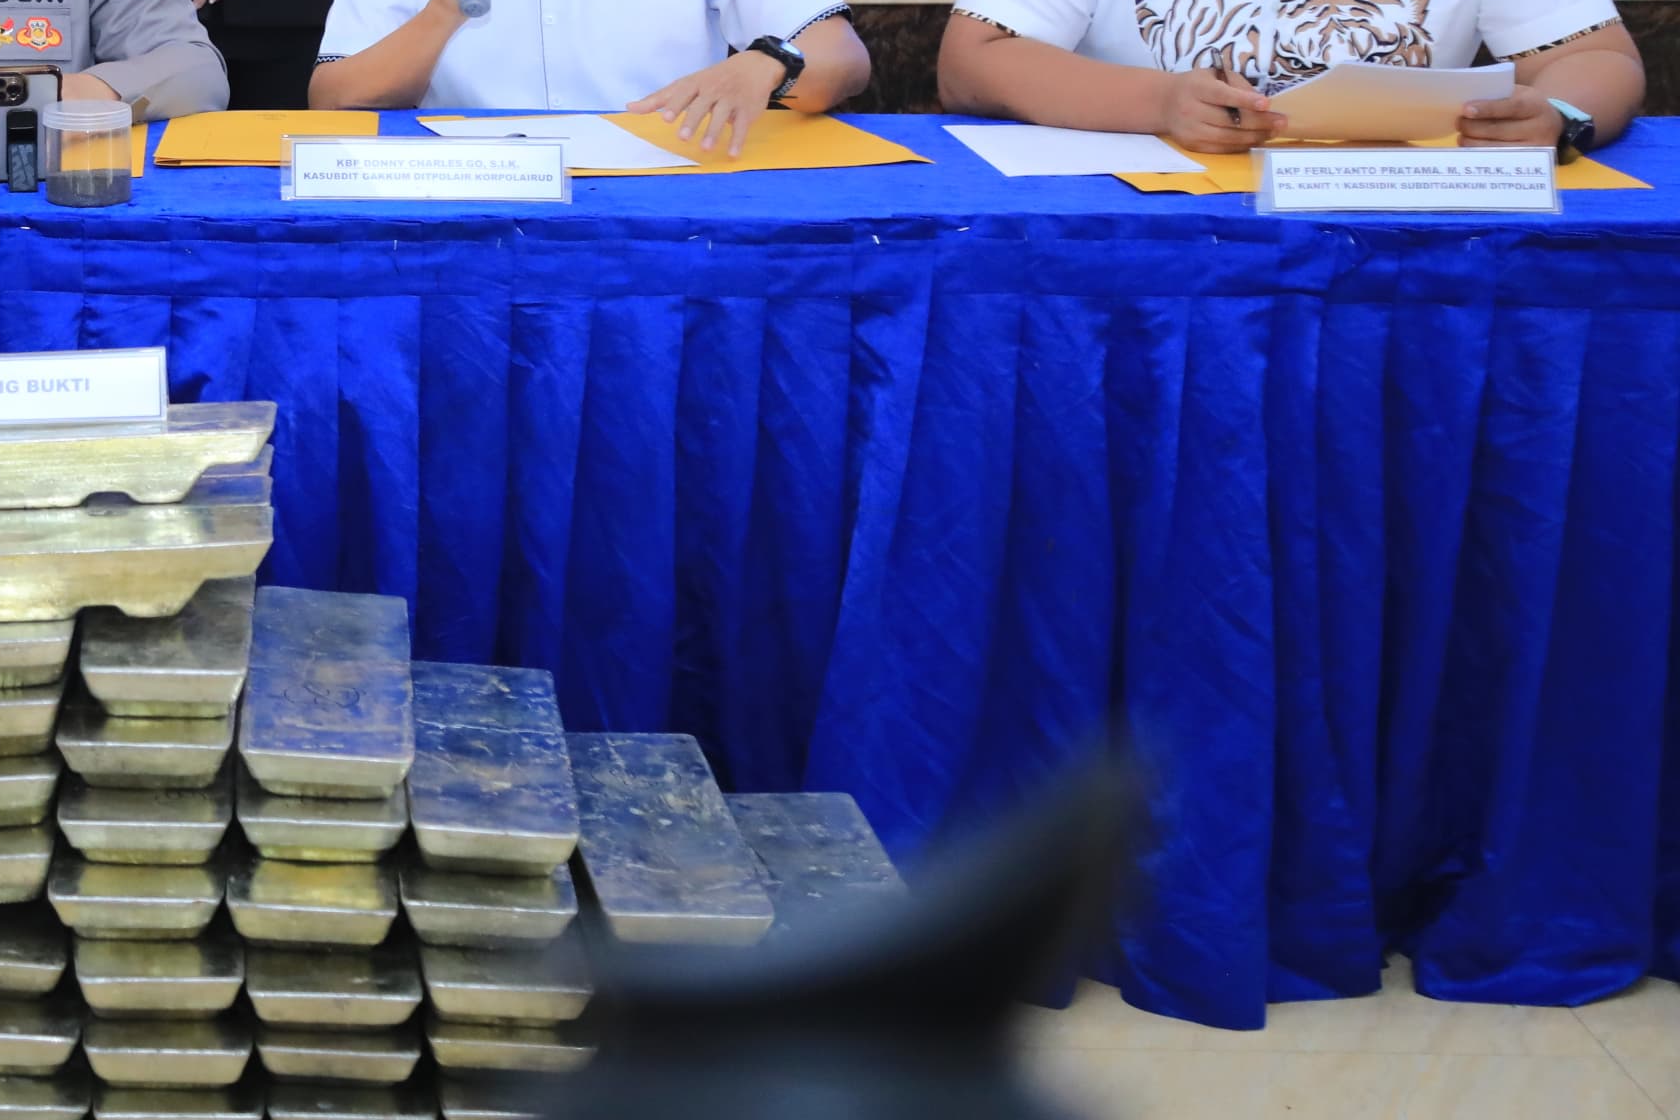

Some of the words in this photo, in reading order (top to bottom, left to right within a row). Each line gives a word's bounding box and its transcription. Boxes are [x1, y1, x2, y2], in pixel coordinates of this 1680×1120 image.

[363, 159, 405, 168] DONNY
[407, 159, 463, 168] CHARLES
[489, 159, 520, 169] S.I.K.
[1276, 167, 1301, 176] AKP
[1514, 167, 1547, 176] S.I.K.
[303, 172, 360, 181] KASUBDIT
[474, 173, 554, 182] KORPOLAIRUD
[1298, 182, 1331, 190] KANIT
[1489, 182, 1547, 191] DITPOLAIR
[26, 378, 90, 394] BUKTI
